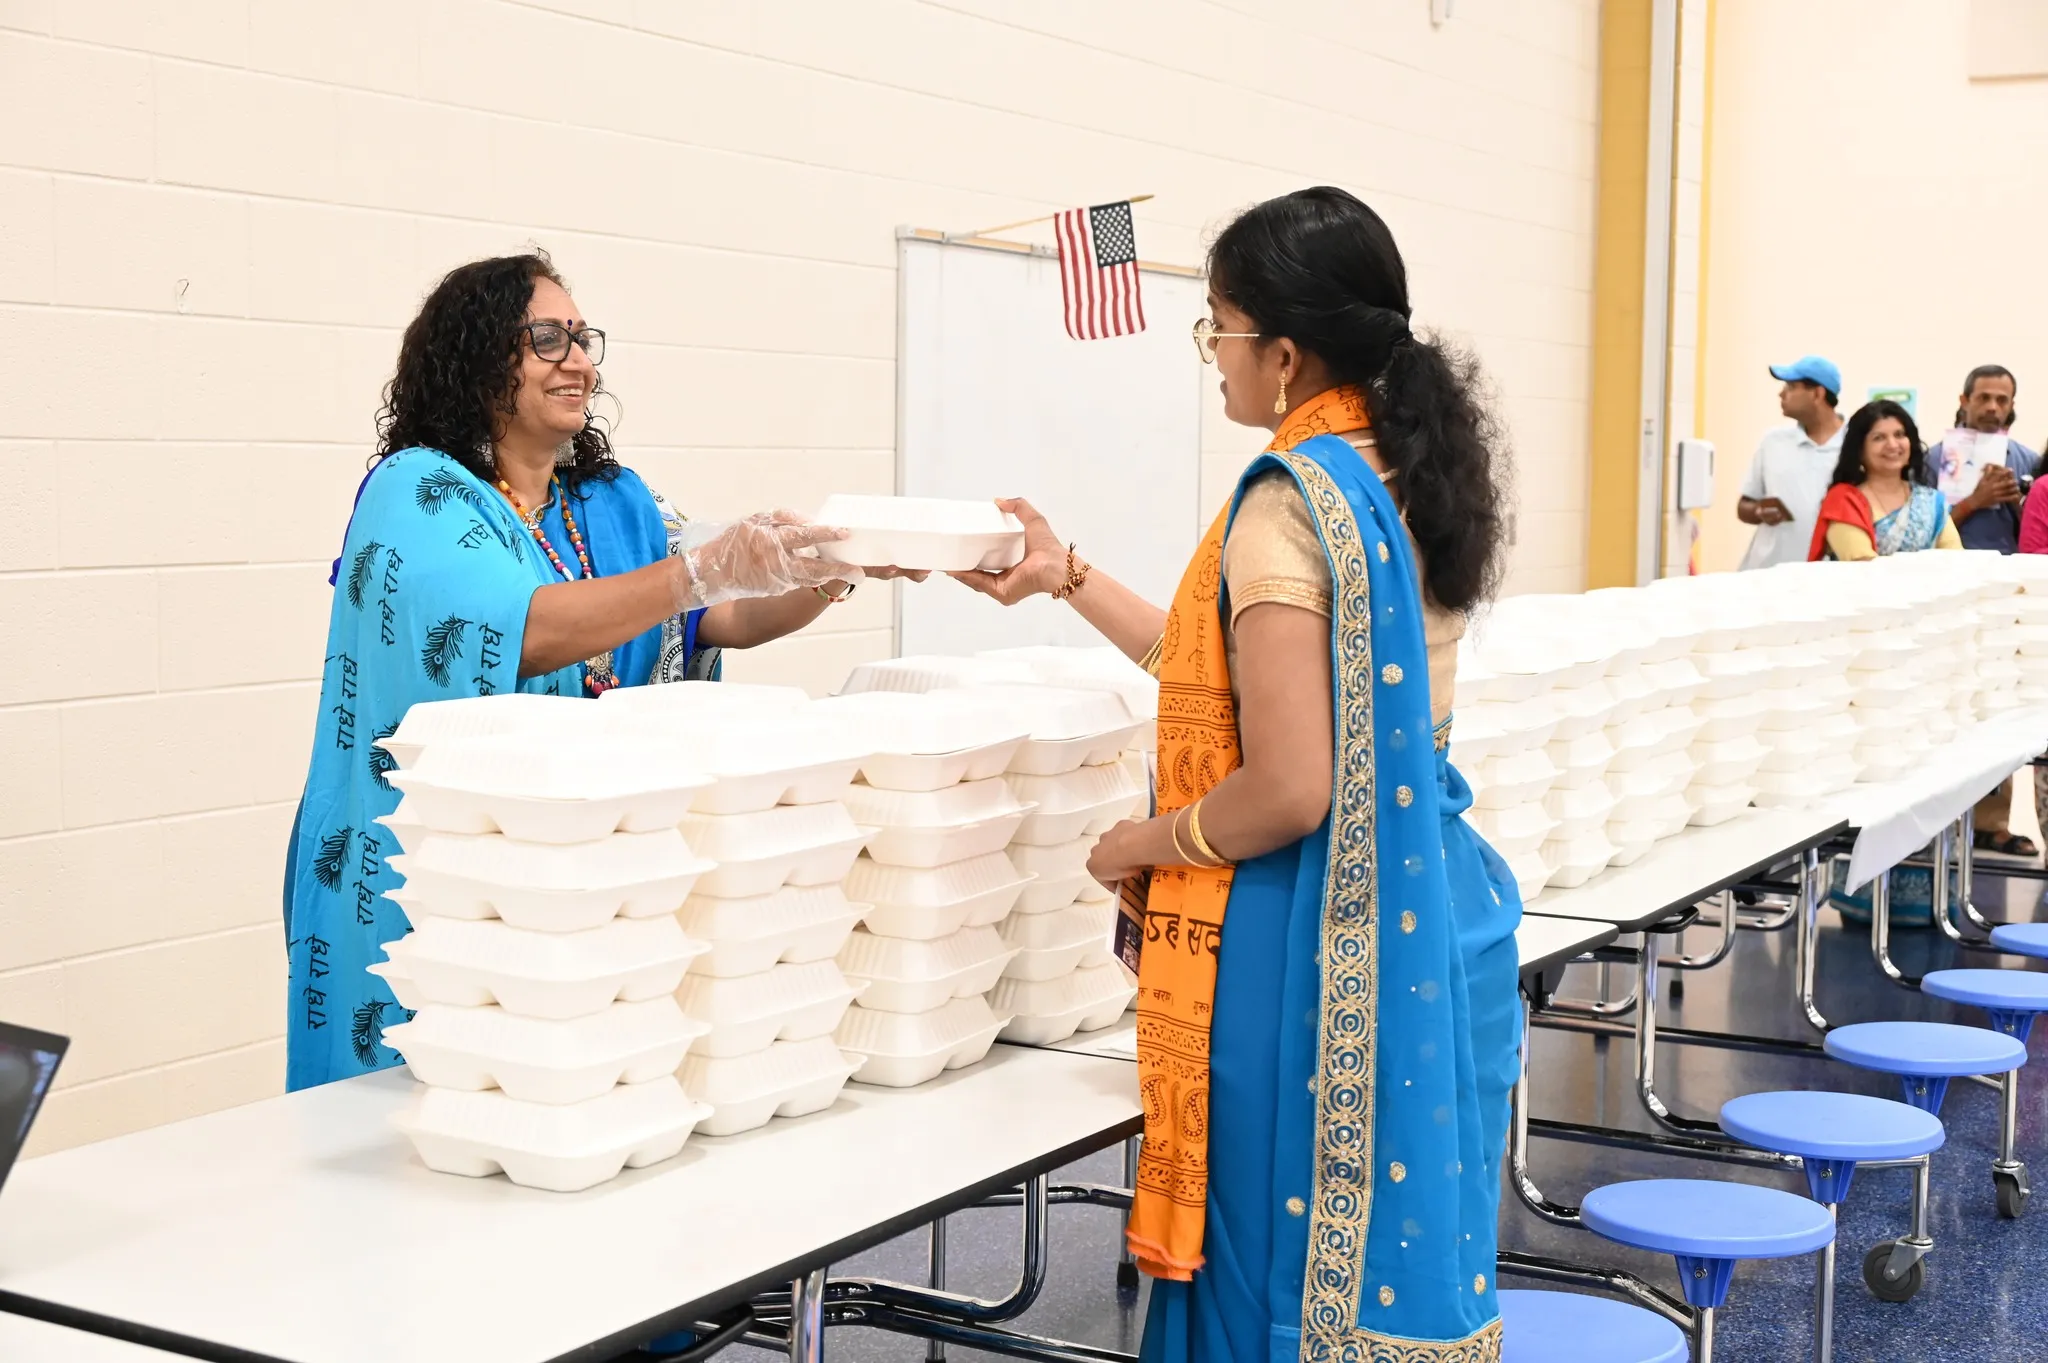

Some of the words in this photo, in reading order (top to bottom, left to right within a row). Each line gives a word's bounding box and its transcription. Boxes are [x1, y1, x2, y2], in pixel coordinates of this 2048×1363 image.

[457, 519, 493, 550] राधे
[384, 547, 404, 595] राधे
[379, 597, 395, 646] राधे
[478, 623, 504, 670] राधे
[338, 652, 358, 700] राधे
[332, 703, 356, 751] राधे
[357, 831, 381, 877] राधे
[352, 880, 376, 926] राधे
[305, 933, 331, 979] राधे
[303, 984, 327, 1030] राधे
